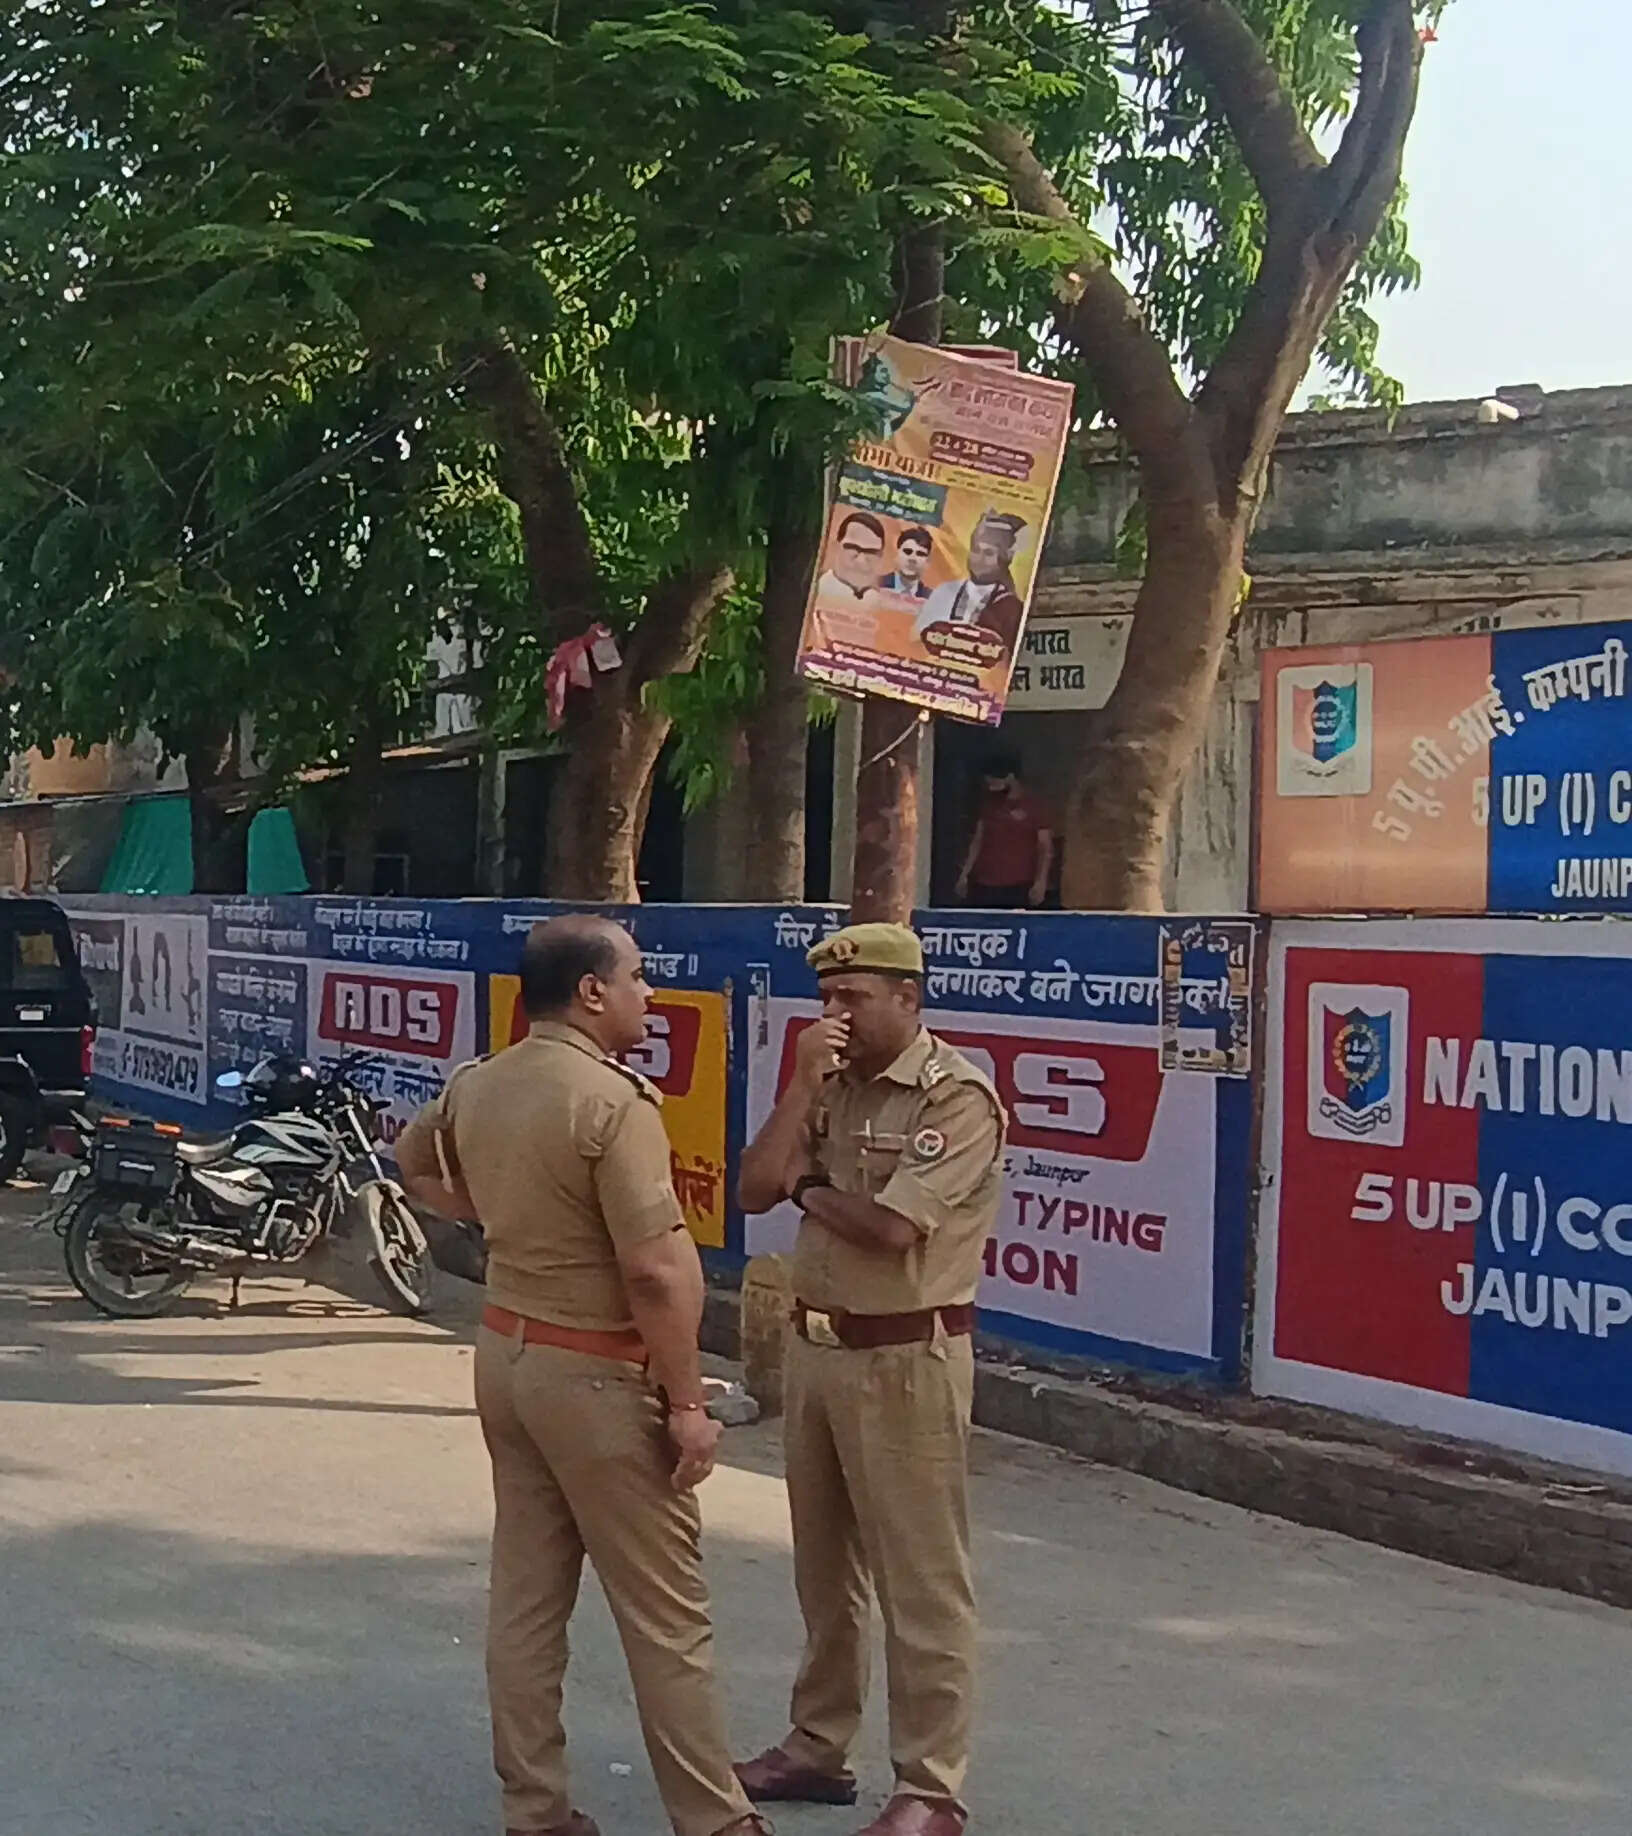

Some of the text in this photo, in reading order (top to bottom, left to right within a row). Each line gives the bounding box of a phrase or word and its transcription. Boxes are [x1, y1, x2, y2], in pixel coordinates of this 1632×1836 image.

[1040, 665, 1086, 690] भारत
[1522, 638, 1628, 711] कम्पनी
[1502, 774, 1547, 826] UP
[927, 965, 1026, 1003] लगाकर
[1030, 958, 1080, 1002] बने
[335, 981, 441, 1044] ADS
[1012, 1190, 1168, 1253] TYPING
[1350, 1172, 1395, 1222] 5
